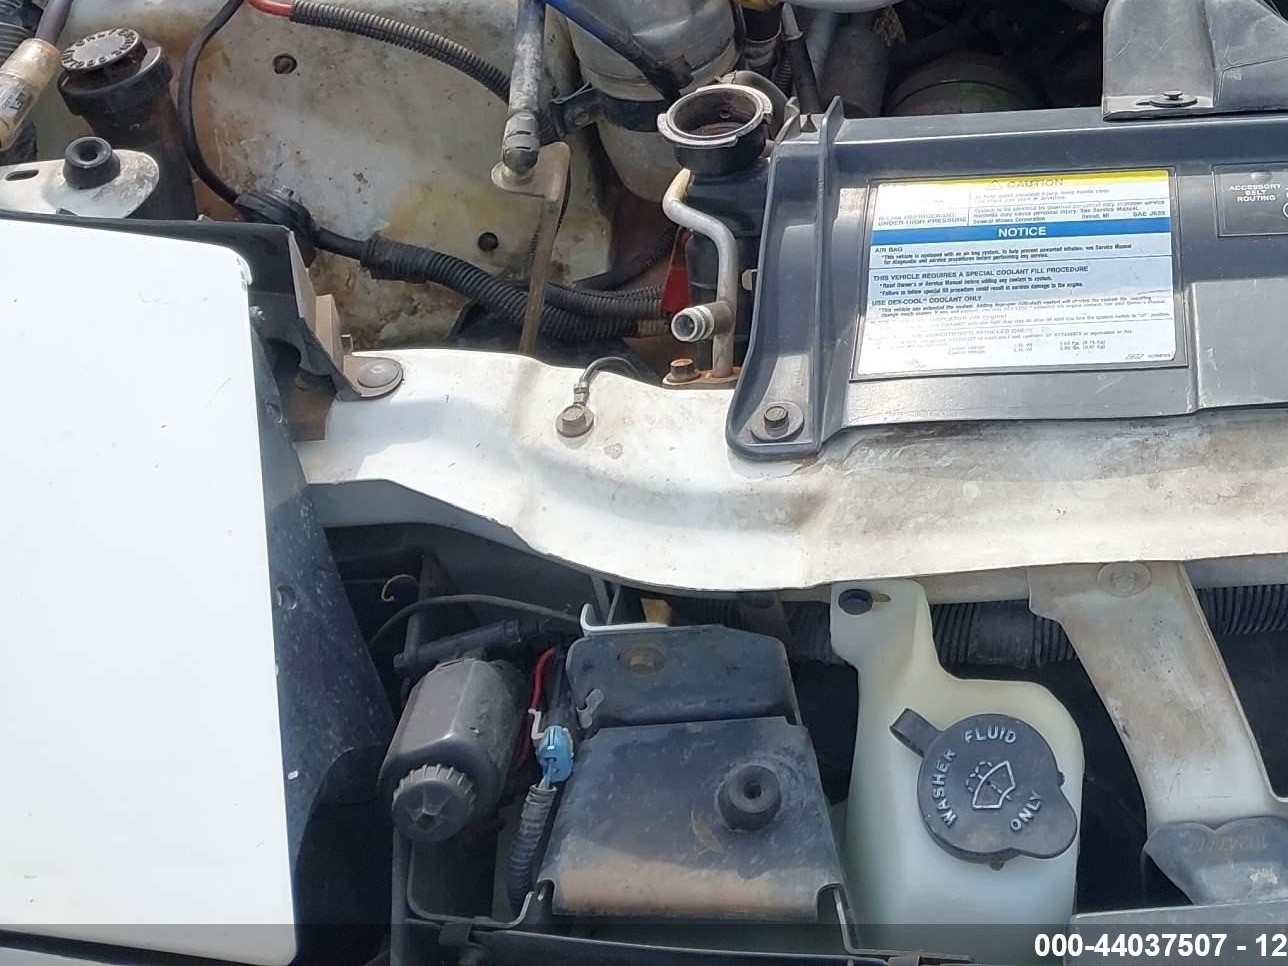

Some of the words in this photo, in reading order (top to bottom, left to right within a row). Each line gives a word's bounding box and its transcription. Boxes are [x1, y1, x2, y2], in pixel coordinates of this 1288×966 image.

[1228, 183, 1281, 191] ACCESSORY
[1236, 195, 1276, 203] ROUTING
[998, 226, 1047, 238] NOTICE
[921, 271, 956, 279] REQUIRES
[1046, 265, 1088, 273] PROCEDURE
[928, 295, 962, 303] COOLANT
[964, 725, 1017, 744] FLUID
[931, 748, 957, 826] WASHER
[1010, 790, 1042, 831] ONLY
